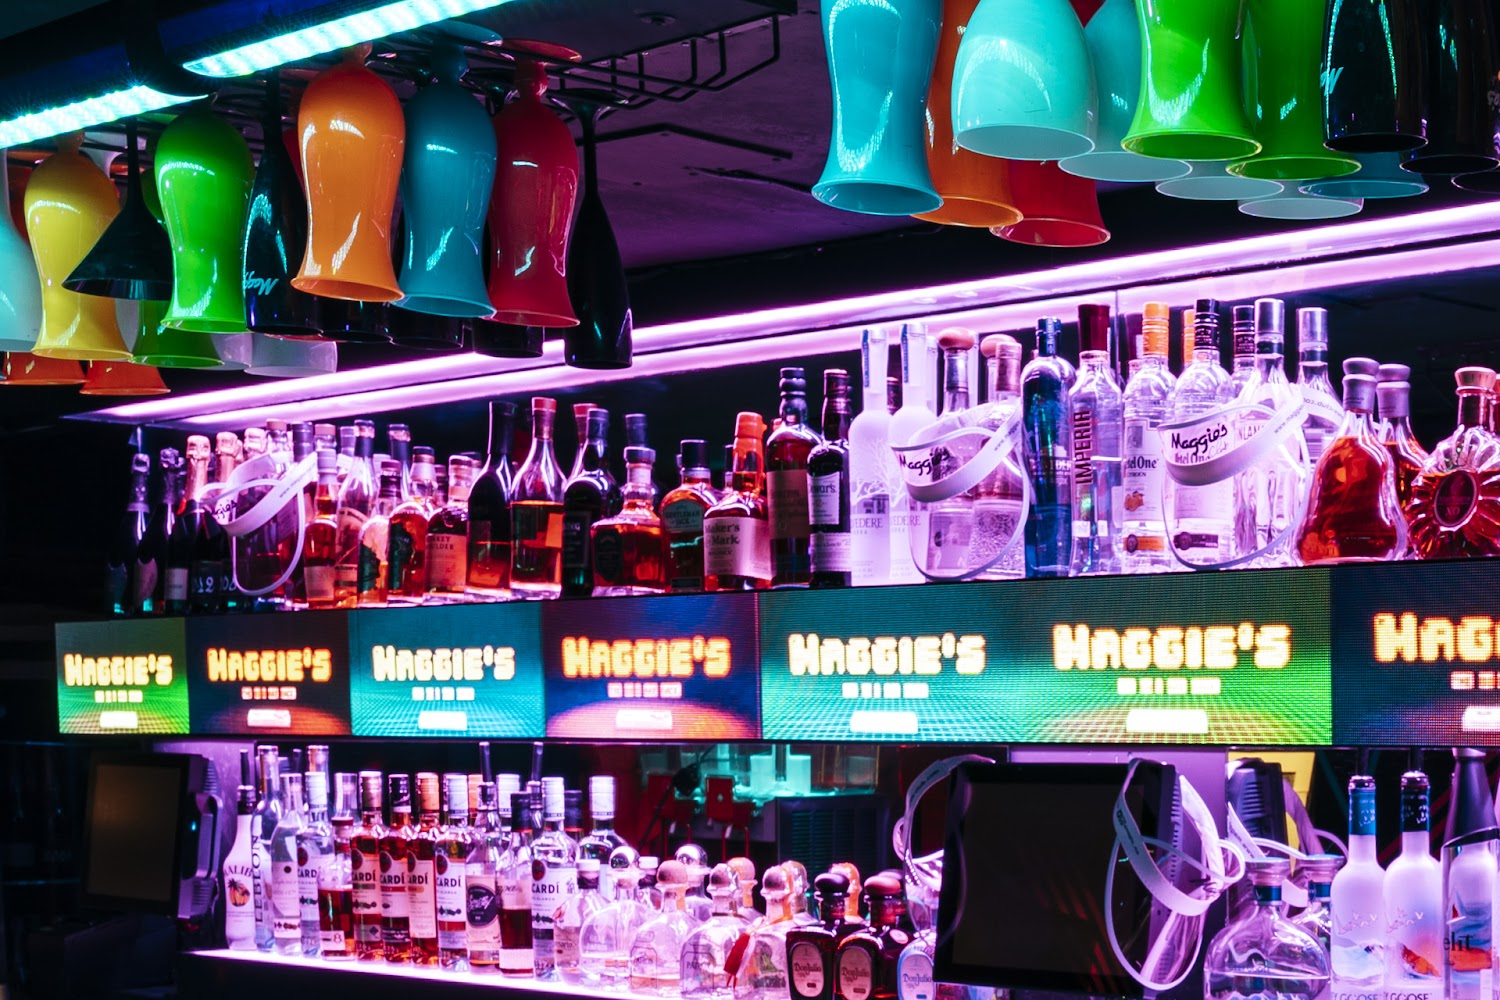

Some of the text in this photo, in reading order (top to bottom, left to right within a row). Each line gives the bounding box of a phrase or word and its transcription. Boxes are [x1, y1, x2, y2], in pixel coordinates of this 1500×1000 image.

[1074, 411, 1093, 484] IMPERIA
[1137, 455, 1157, 469] One
[706, 522, 740, 535] Maker's
[712, 533, 739, 546] Mark
[372, 645, 516, 683] MAGGIE'S
[562, 636, 732, 679] MAGGIE'S
[788, 632, 987, 676] MAGGIE'S
[1053, 622, 1292, 670] MAGGIE'S
[63, 652, 172, 687] MAGGIE'S
[206, 648, 332, 684] MAGGIE'S
[1443, 931, 1475, 951] elit
